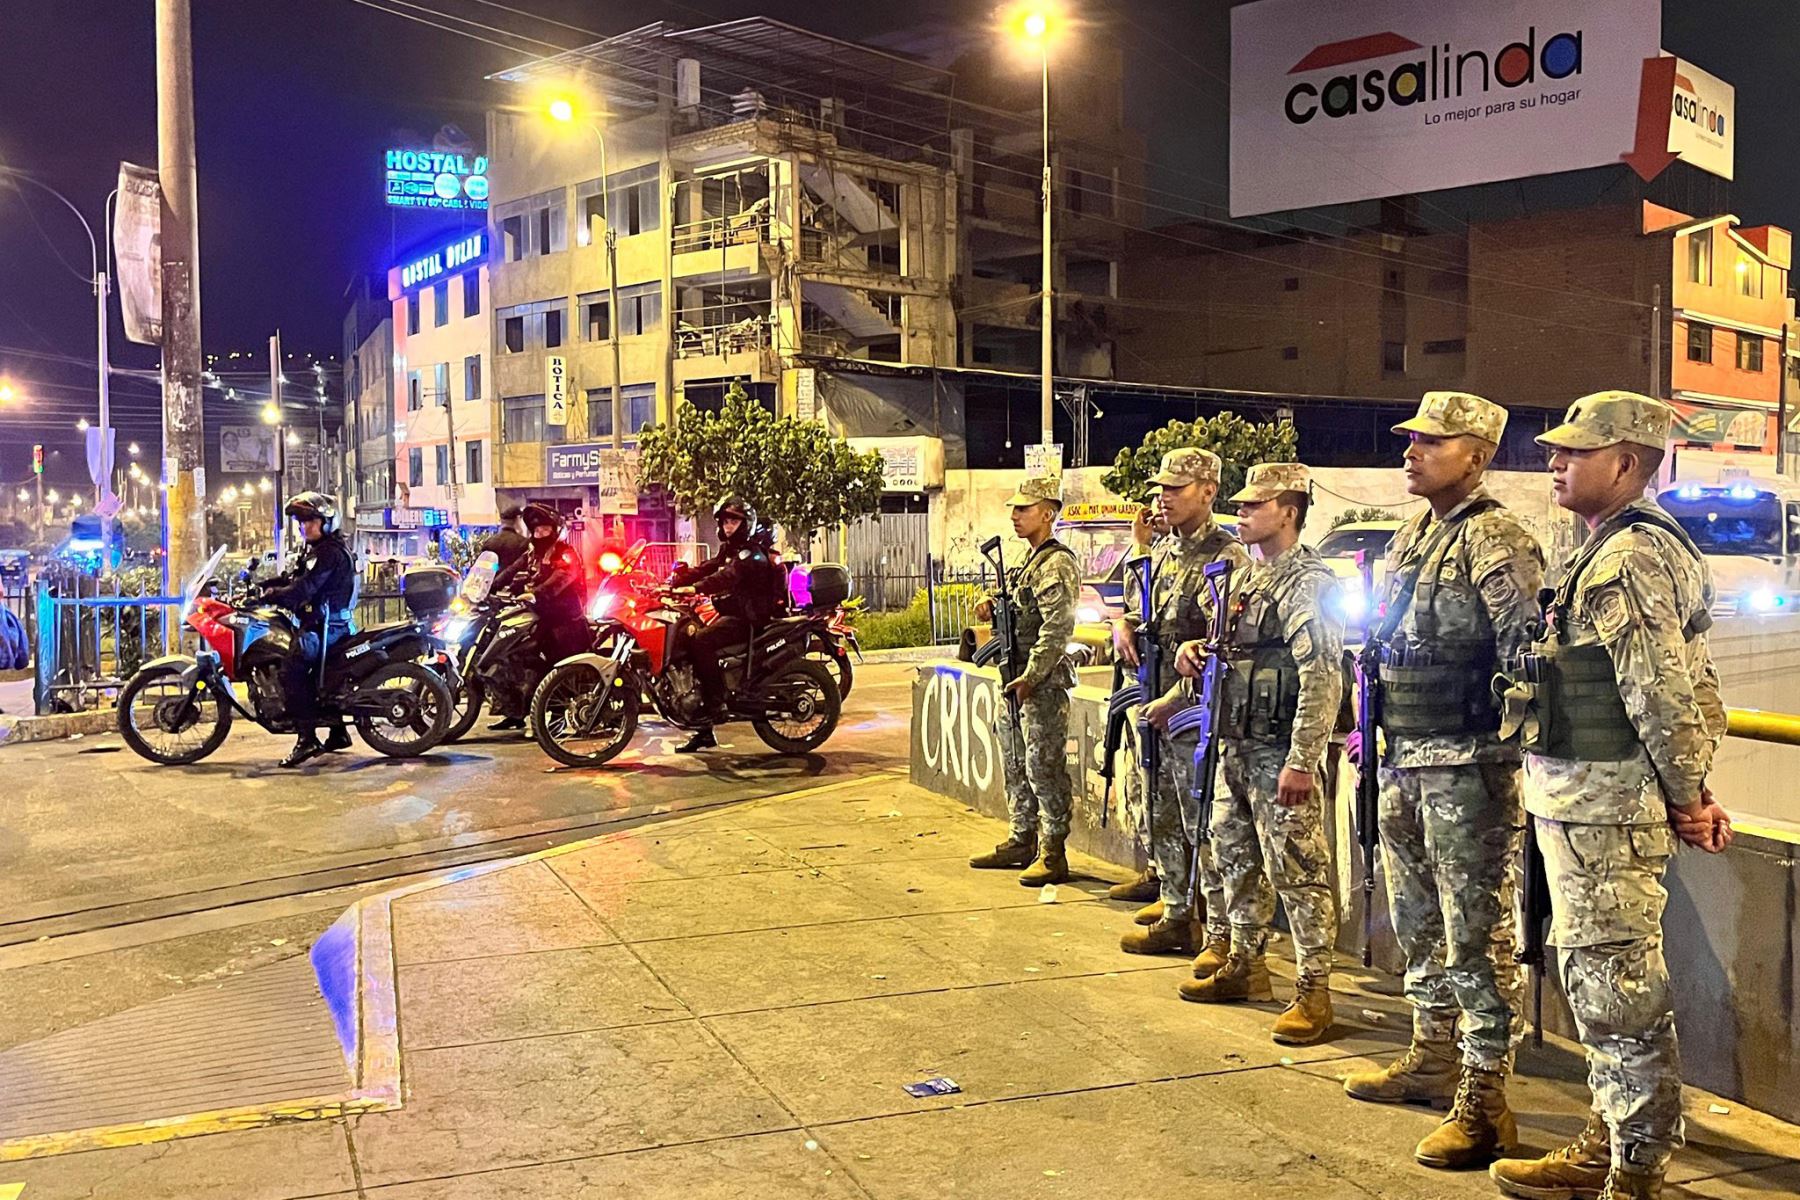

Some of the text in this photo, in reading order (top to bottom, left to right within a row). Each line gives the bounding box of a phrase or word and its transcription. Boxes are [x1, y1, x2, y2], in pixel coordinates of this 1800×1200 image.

[1284, 26, 1582, 124] casalinda
[1424, 88, 1581, 125] Lo mejor para su hogar
[1673, 92, 1725, 137] asalinda
[386, 150, 469, 174] HOSTAL
[552, 358, 563, 410] BOTICA
[552, 450, 600, 470] FarmyS
